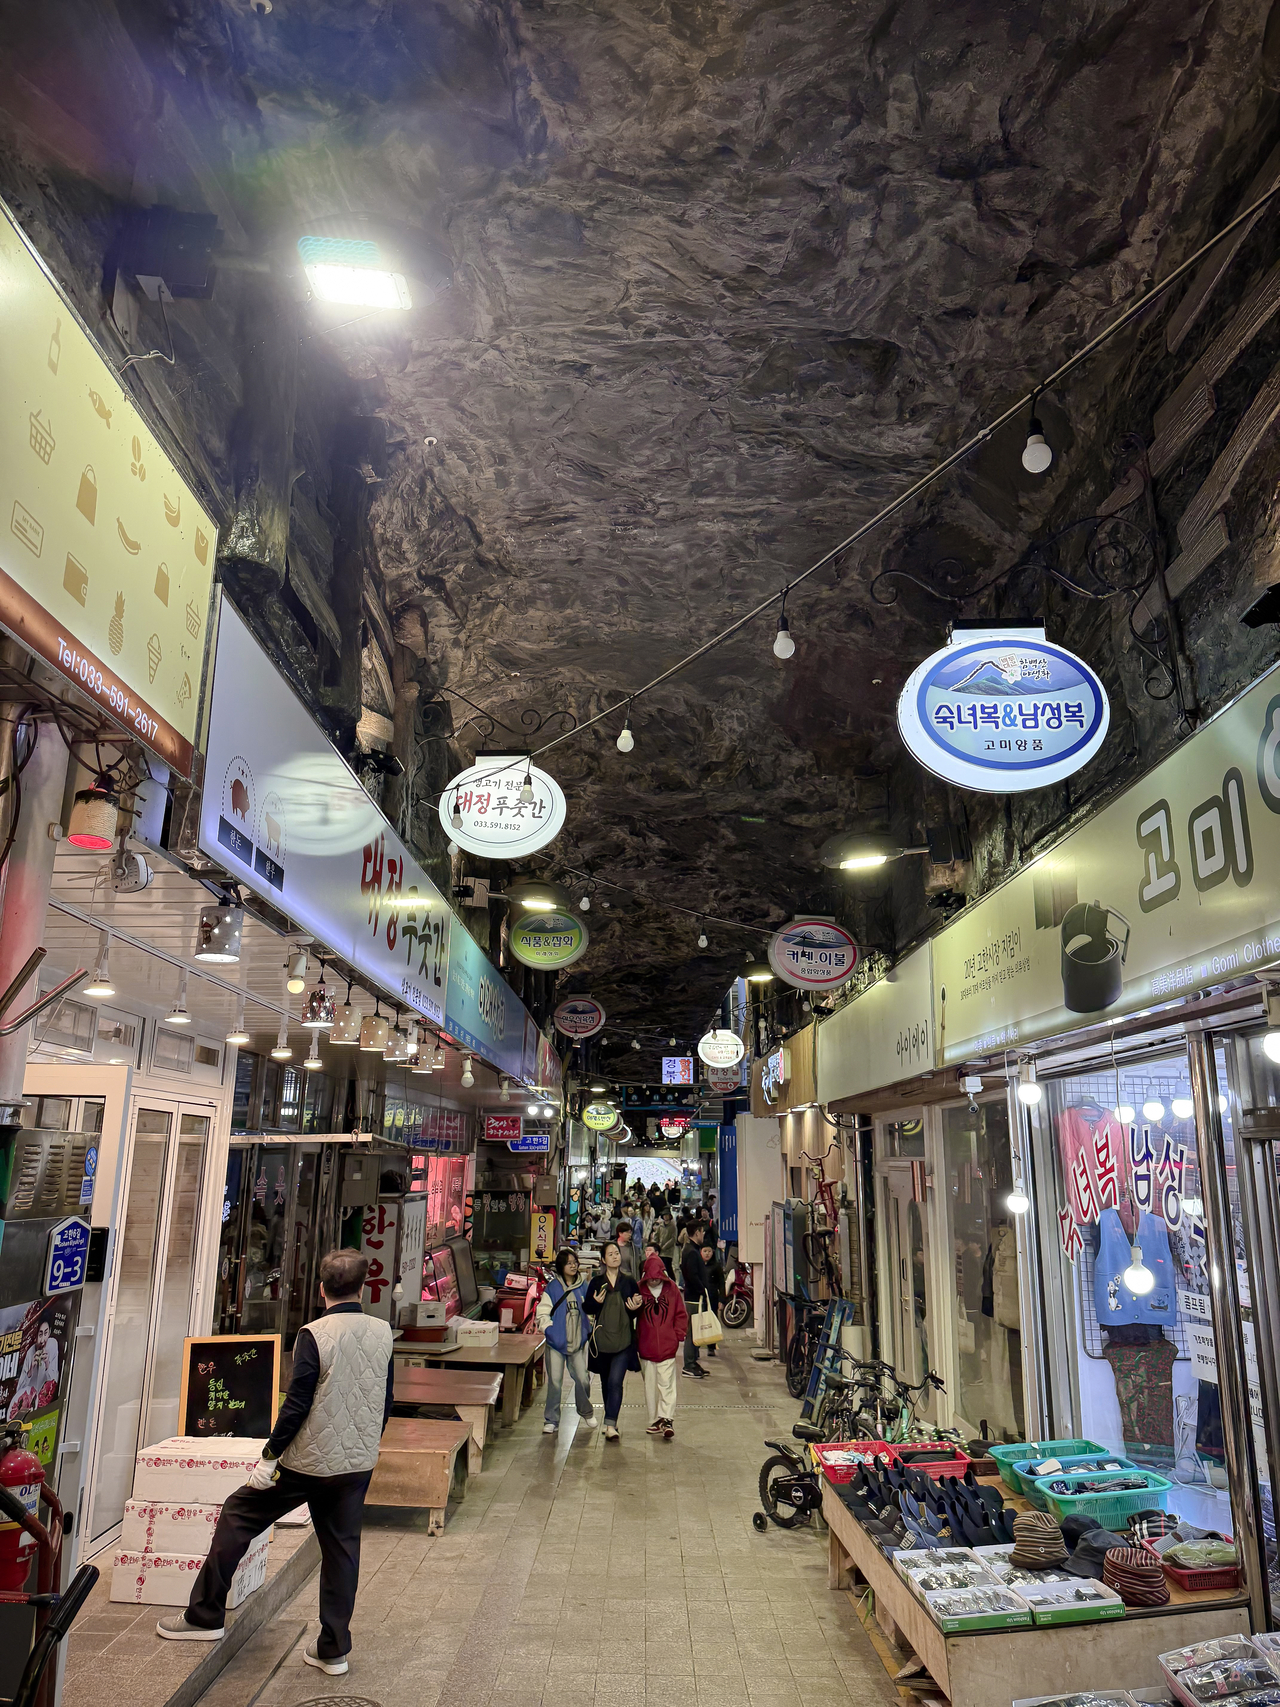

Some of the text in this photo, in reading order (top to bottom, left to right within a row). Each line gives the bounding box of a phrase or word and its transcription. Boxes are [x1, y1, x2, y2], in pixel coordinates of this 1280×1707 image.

[1020, 657, 1047, 669] 함백산
[1022, 669, 1050, 680] 야생화
[58, 637, 158, 740] Tel:033-591-2617
[934, 702, 1085, 731] 숙녀복&남성복
[984, 739, 1044, 751] 고미양품
[473, 820, 521, 831] 033.591.8152
[520, 935, 574, 948] 식품&잡화
[1211, 948, 1240, 975] Gomi
[362, 1205, 396, 1304] 한우
[52, 1256, 82, 1286] 9-3
